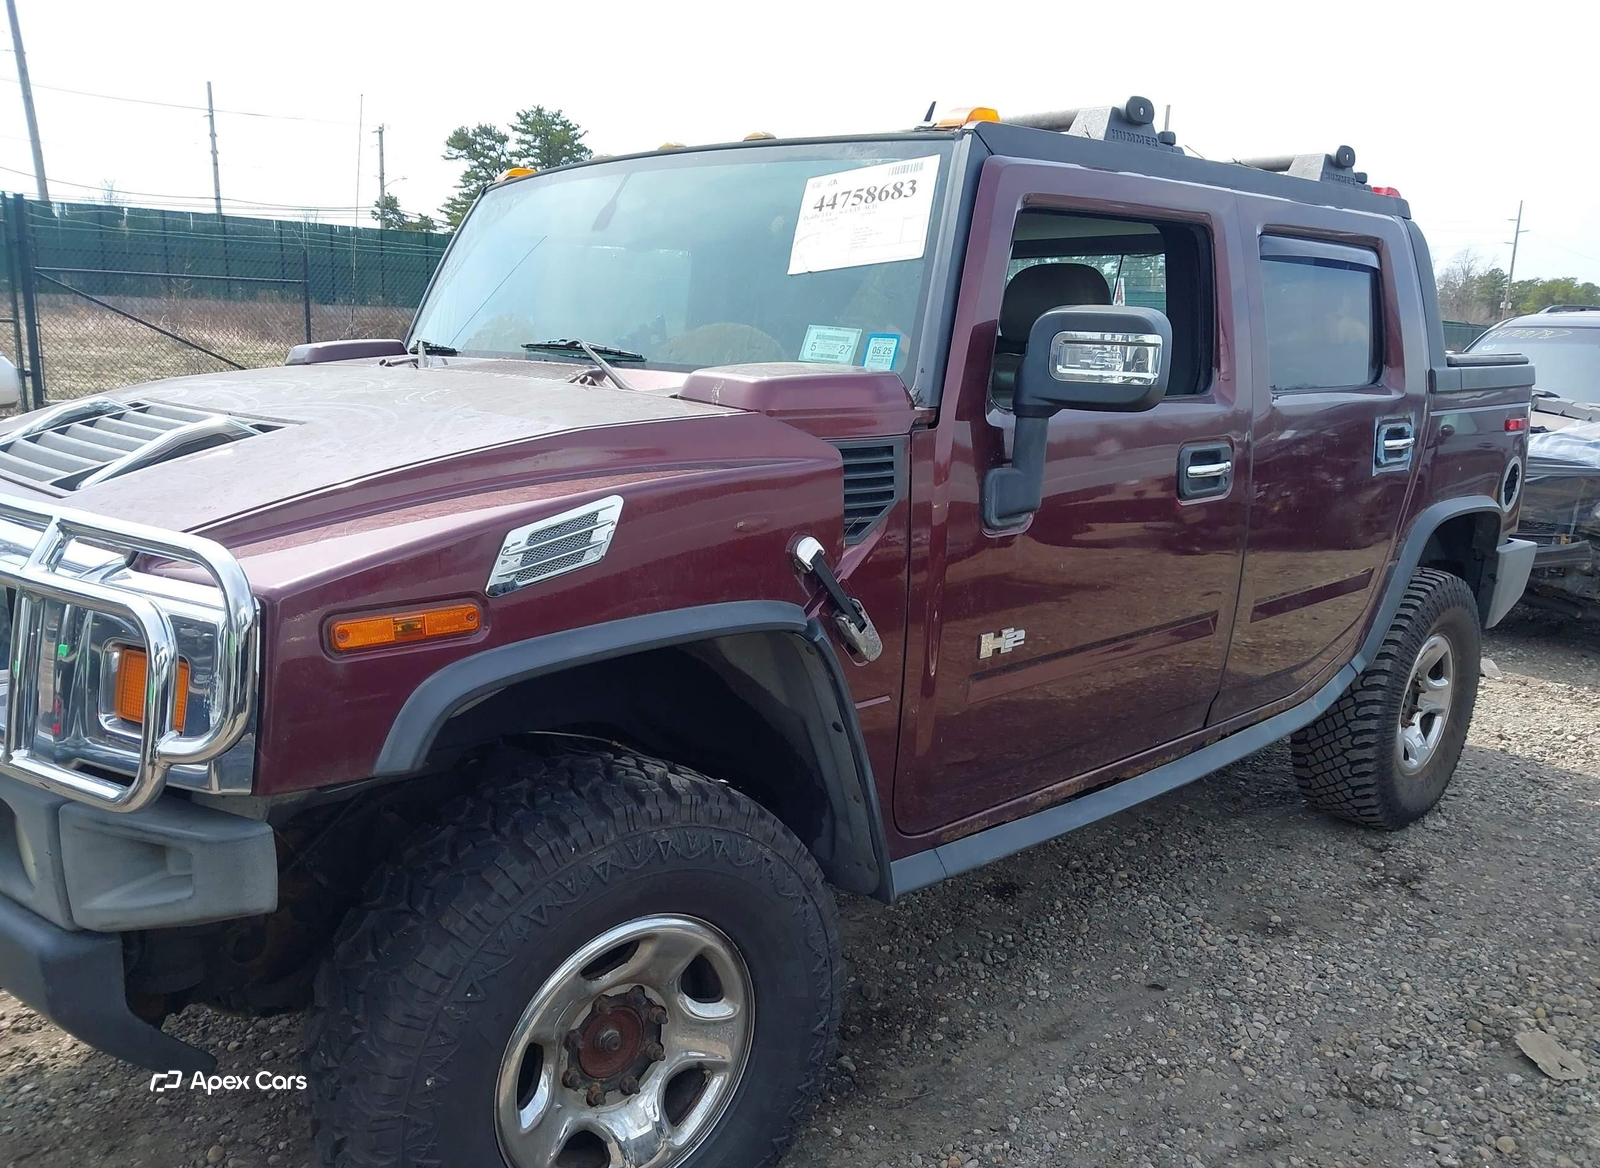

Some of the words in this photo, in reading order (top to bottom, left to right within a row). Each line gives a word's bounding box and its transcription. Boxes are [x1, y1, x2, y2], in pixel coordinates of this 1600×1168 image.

[1111, 128, 1158, 147] HUMMER
[813, 179, 917, 212] 44758683
[810, 341, 817, 351] 5
[838, 344, 852, 355] 27
[978, 626, 1027, 660] H2
